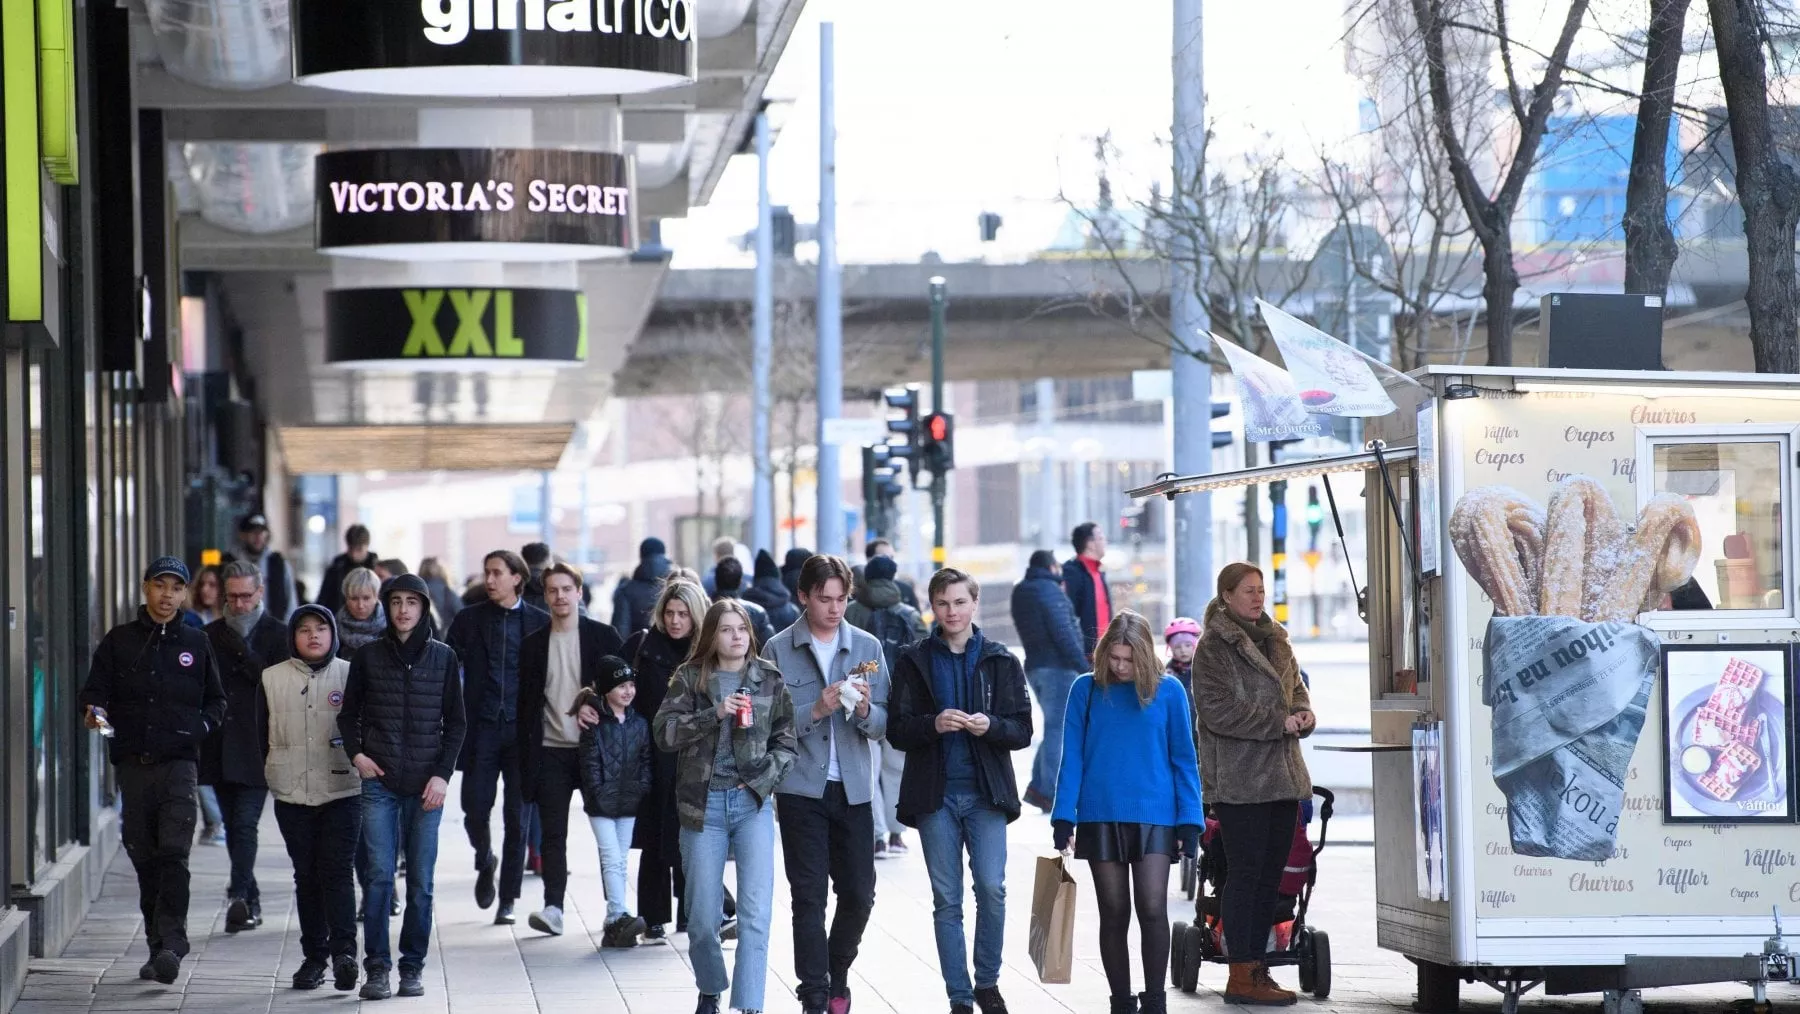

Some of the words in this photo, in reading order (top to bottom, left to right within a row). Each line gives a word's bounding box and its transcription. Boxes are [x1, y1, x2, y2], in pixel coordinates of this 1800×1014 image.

[421, 0, 697, 45] ginatrico
[528, 179, 629, 216] SECRET
[402, 289, 524, 357] XXL
[1630, 403, 1696, 424] Churros
[1484, 425, 1519, 444] Våfflor
[1564, 425, 1615, 449] Crepes
[1475, 448, 1525, 471] Crepes
[1486, 802, 1508, 820] Crep
[1622, 792, 1663, 811] hurr
[1736, 799, 1781, 811] Våfflor
[1486, 841, 1514, 856] Chur
[1664, 836, 1692, 851] Crepes
[1513, 864, 1552, 877] Churros
[1744, 849, 1797, 875] Våfflor
[1569, 872, 1634, 892] Churros
[1657, 868, 1709, 894] Våfflor
[1480, 890, 1516, 909] Våfflor
[1730, 887, 1759, 903] Crepes
